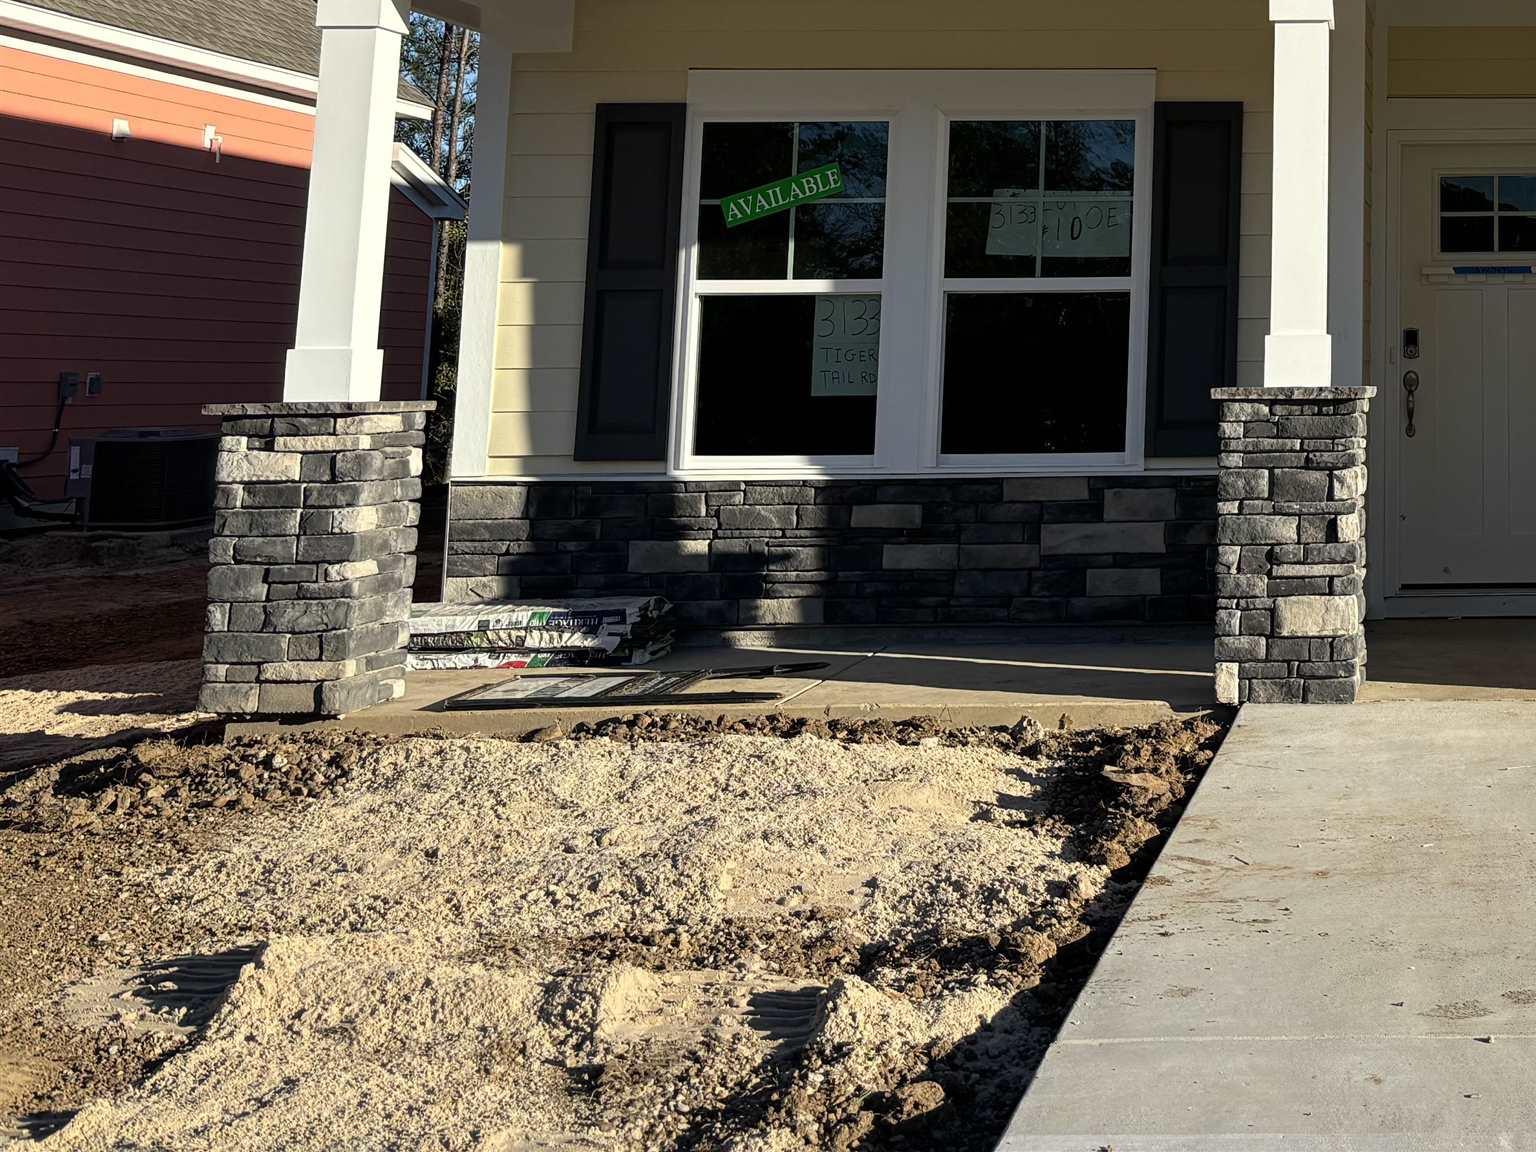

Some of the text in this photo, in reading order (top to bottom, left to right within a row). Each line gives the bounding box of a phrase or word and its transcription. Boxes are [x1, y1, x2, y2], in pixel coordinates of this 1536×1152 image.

[727, 168, 841, 221] AVAILABLE
[817, 299, 881, 337] 3133
[820, 347, 878, 363] TIGER
[819, 370, 878, 389] TAIL RD
